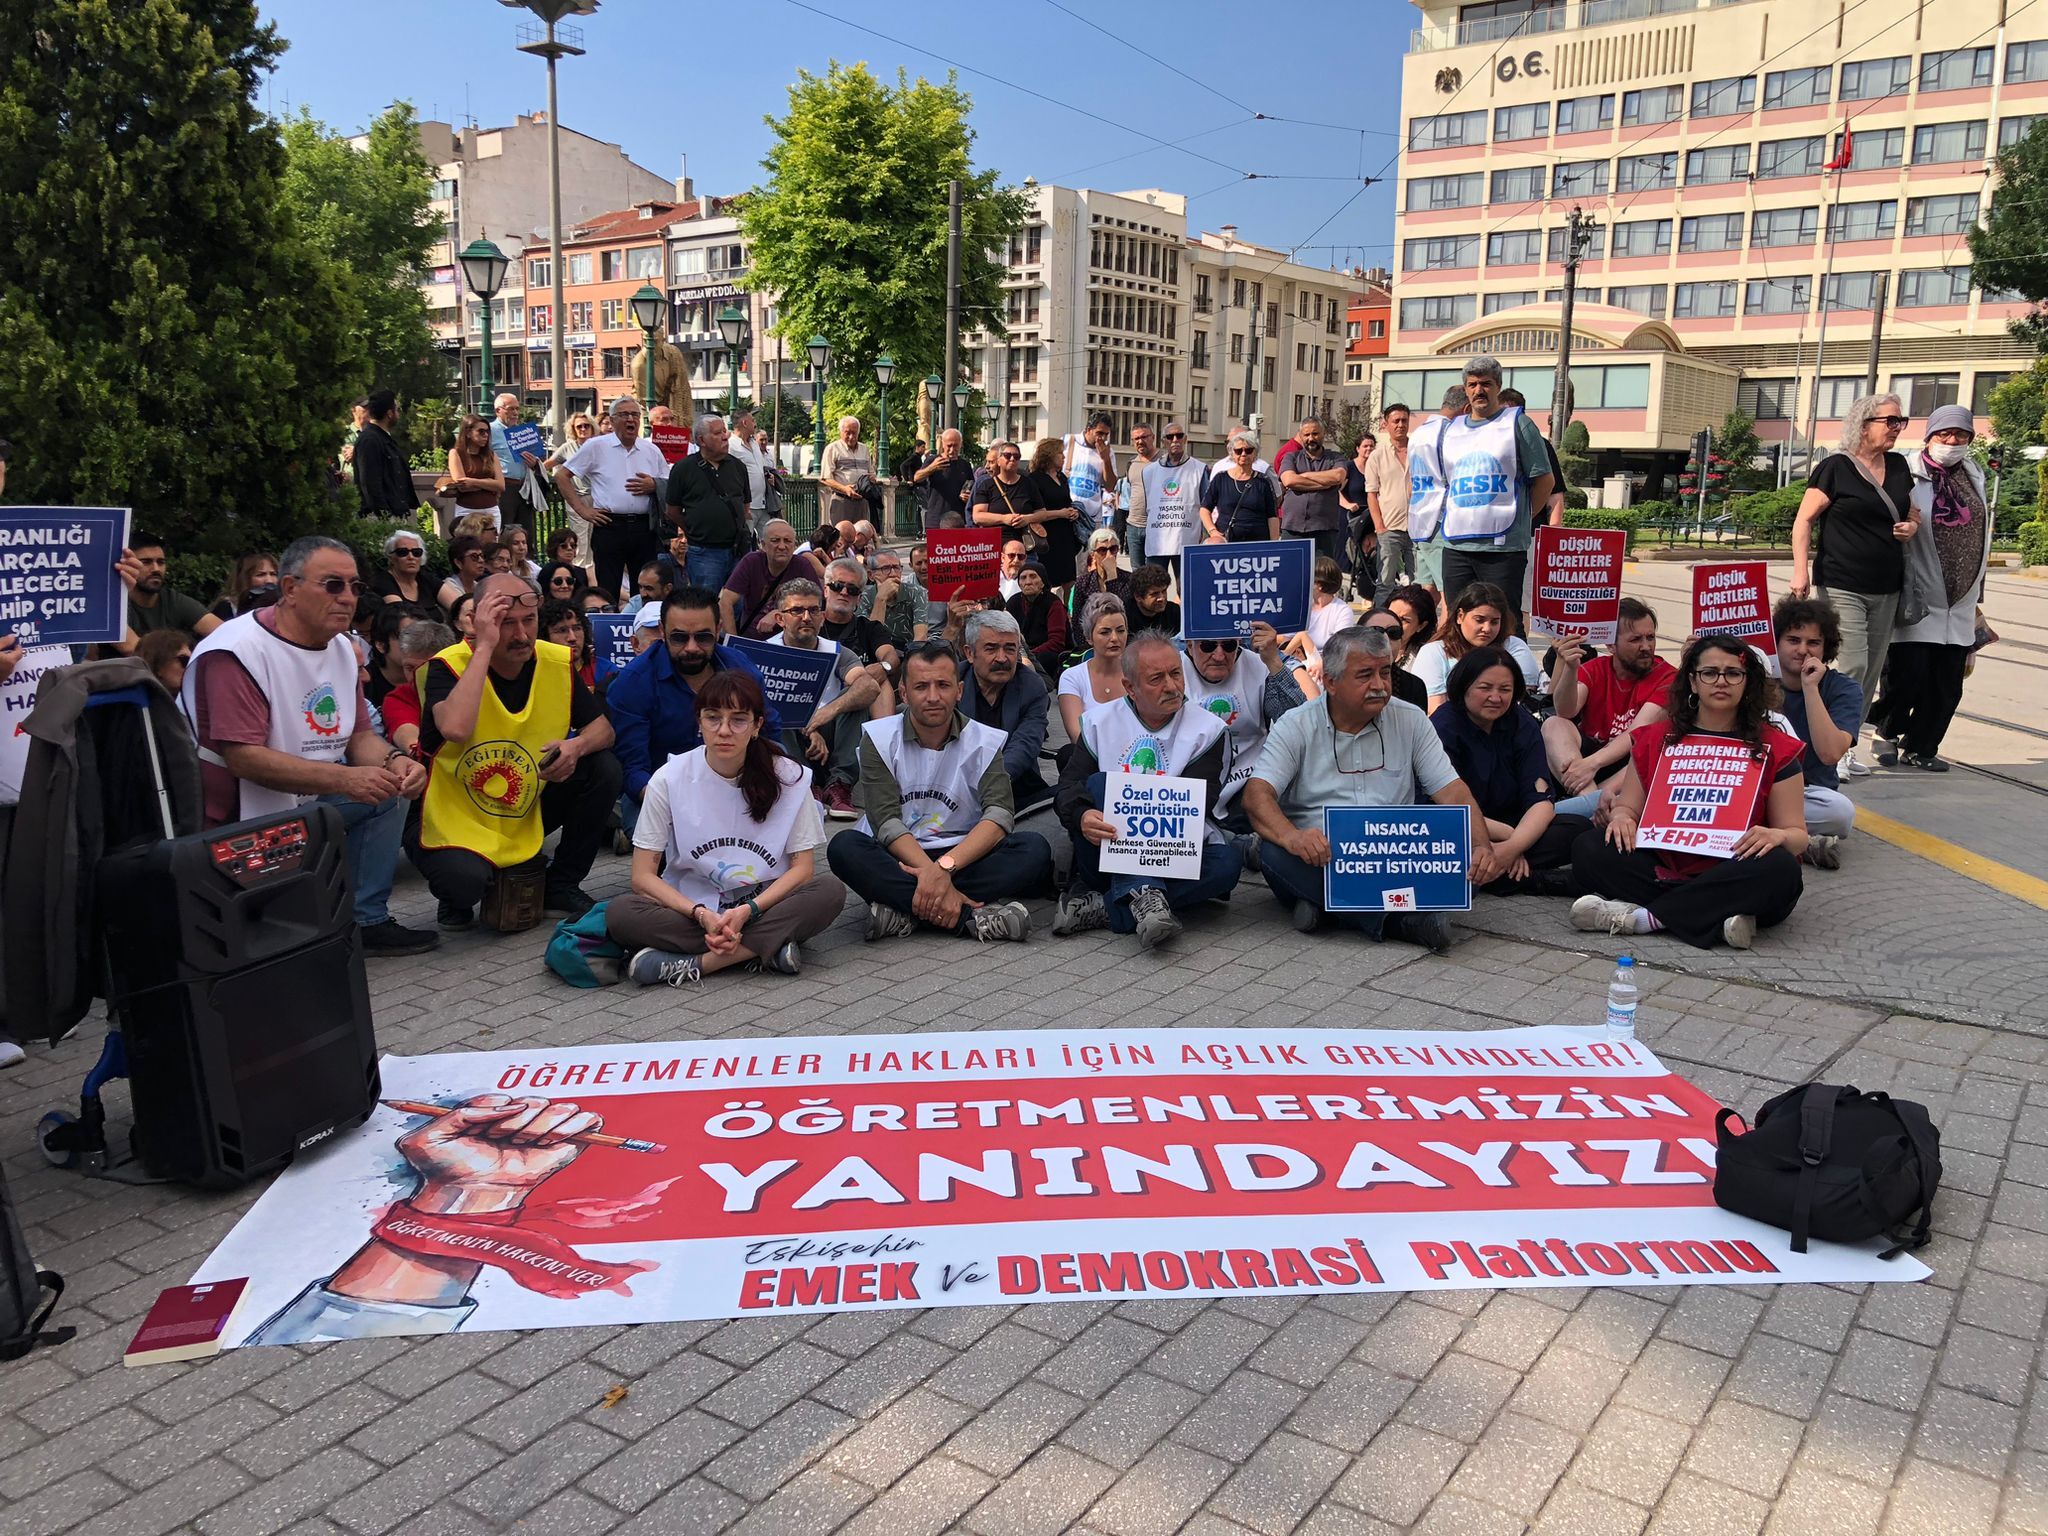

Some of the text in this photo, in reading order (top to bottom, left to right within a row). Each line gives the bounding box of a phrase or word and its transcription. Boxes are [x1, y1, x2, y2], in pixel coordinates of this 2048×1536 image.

[1450, 474, 1508, 497] KESK
[935, 543, 994, 555] Özel Okullar
[1559, 536, 1603, 554] DÜŞÜK
[1210, 556, 1281, 574] YUSUF
[1547, 552, 1612, 568] ÜCRETLERE
[0, 571, 84, 595] LECEĞE
[1214, 573, 1277, 594] TEKİN
[1548, 569, 1609, 584] MÜLAKATA
[1708, 570, 1747, 589] DÜŞÜK
[1541, 586, 1615, 599] GÜVENCESİZLİĞE
[1699, 587, 1758, 607] ÜCRETLERE
[0, 596, 86, 620] HİP ÇIK!
[1210, 594, 1283, 615] İSTİFA!
[1565, 603, 1585, 613] SON
[1700, 604, 1758, 623] MÜLAKATA
[11, 622, 40, 637] SOL
[19, 633, 41, 645] PARTİ
[786, 692, 813, 703] DEĞİL
[1670, 758, 1749, 773] EMEKÇİLERE
[1667, 772, 1744, 786] EMEKLİLERE
[1122, 784, 1190, 802] Özel Okul
[1670, 788, 1729, 804] HEMEN
[1114, 802, 1199, 817] Sömürüsüne
[1676, 807, 1713, 822] ZAM
[1127, 817, 1185, 838] SON!
[1364, 821, 1430, 836] İNSANCA
[1110, 838, 1144, 847] Herkese
[1147, 839, 1186, 848] Güvenceli
[1661, 830, 1708, 847] EHP
[690, 837, 777, 868] ÖĞRETMEN SENDİKASI
[1108, 846, 1197, 857] insanca yaşanabilecek
[1339, 839, 1456, 857] YAŞANACAK BİR
[1139, 856, 1170, 867] ücret!
[1335, 859, 1462, 874] ÜCRET İSTİYORUZ
[1388, 894, 1409, 903] SOL
[497, 1042, 1642, 1090] ÖĞRETMENLER HAKLARI İÇİN AÇLIK GREVİNDELER!
[703, 1087, 1692, 1139] ÖĞRETMENLERİMİZİN
[299, 1126, 334, 1149] KORAX
[386, 1217, 612, 1288] ÖĞRETMENİN HAKKINI VER!
[745, 1233, 925, 1265] Eskişehir
[738, 1238, 1781, 1309] EMEK Ve DEMOKRASİ Platformu
